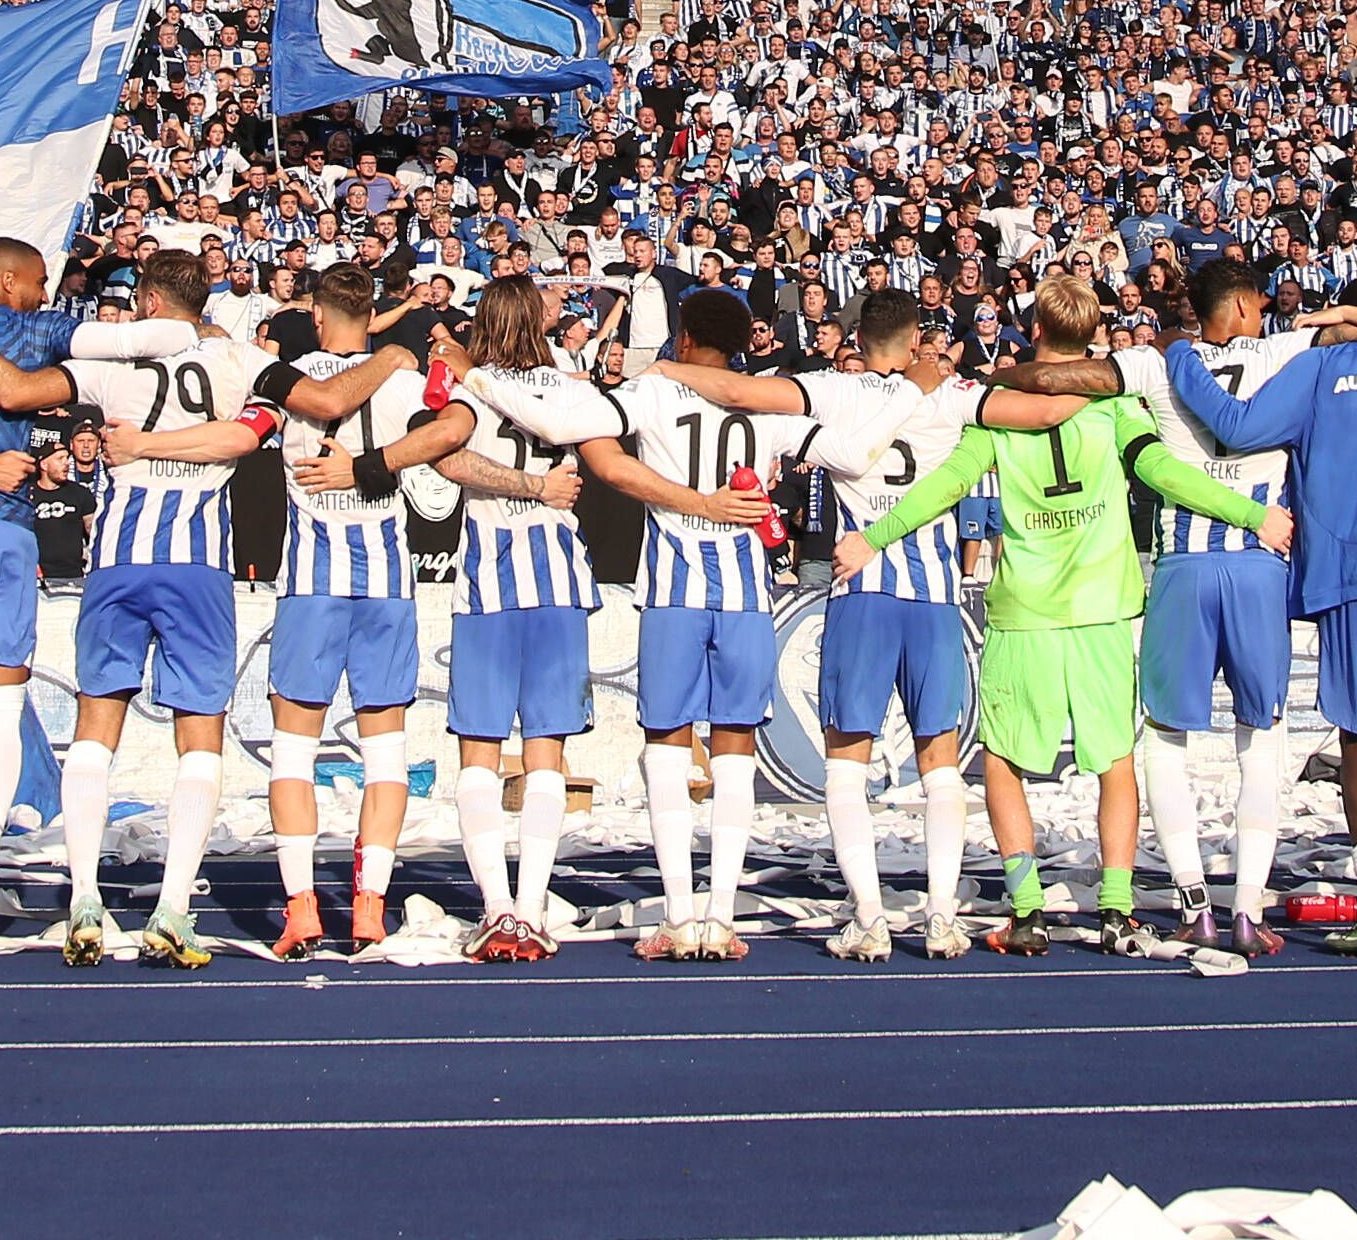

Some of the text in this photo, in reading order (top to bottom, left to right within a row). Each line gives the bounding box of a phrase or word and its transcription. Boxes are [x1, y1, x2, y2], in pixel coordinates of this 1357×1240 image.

[1240, 338, 1264, 355] BSC
[134, 360, 215, 432] 79
[676, 412, 756, 492] 10
[1044, 428, 1083, 498] 1
[1203, 460, 1242, 480] SELKE
[1024, 499, 1106, 530] CHRISTENSEN
